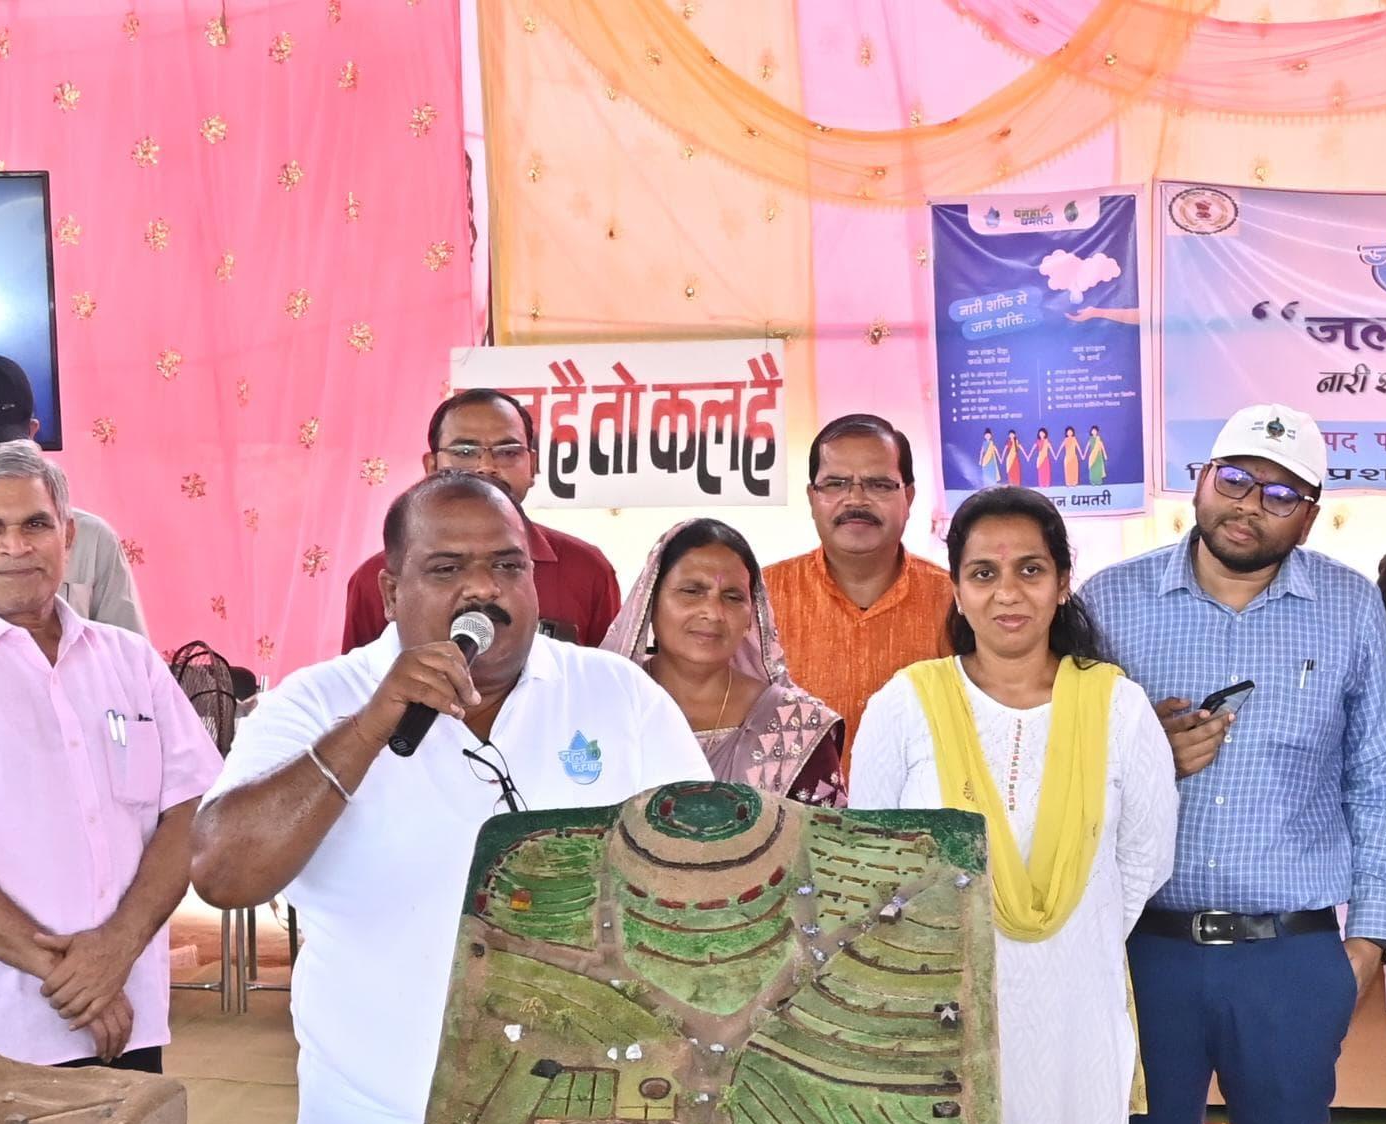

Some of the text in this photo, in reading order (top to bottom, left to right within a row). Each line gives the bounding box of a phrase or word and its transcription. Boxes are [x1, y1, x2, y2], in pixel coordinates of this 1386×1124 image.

[958, 290, 1029, 317] नारी शक्ति से
[971, 319, 993, 334] जल
[1316, 363, 1370, 394] नारी
[548, 359, 587, 499] है
[588, 361, 647, 476] तो
[649, 380, 747, 495] कल
[742, 352, 784, 497] है
[1071, 489, 1112, 507] धमतरी
